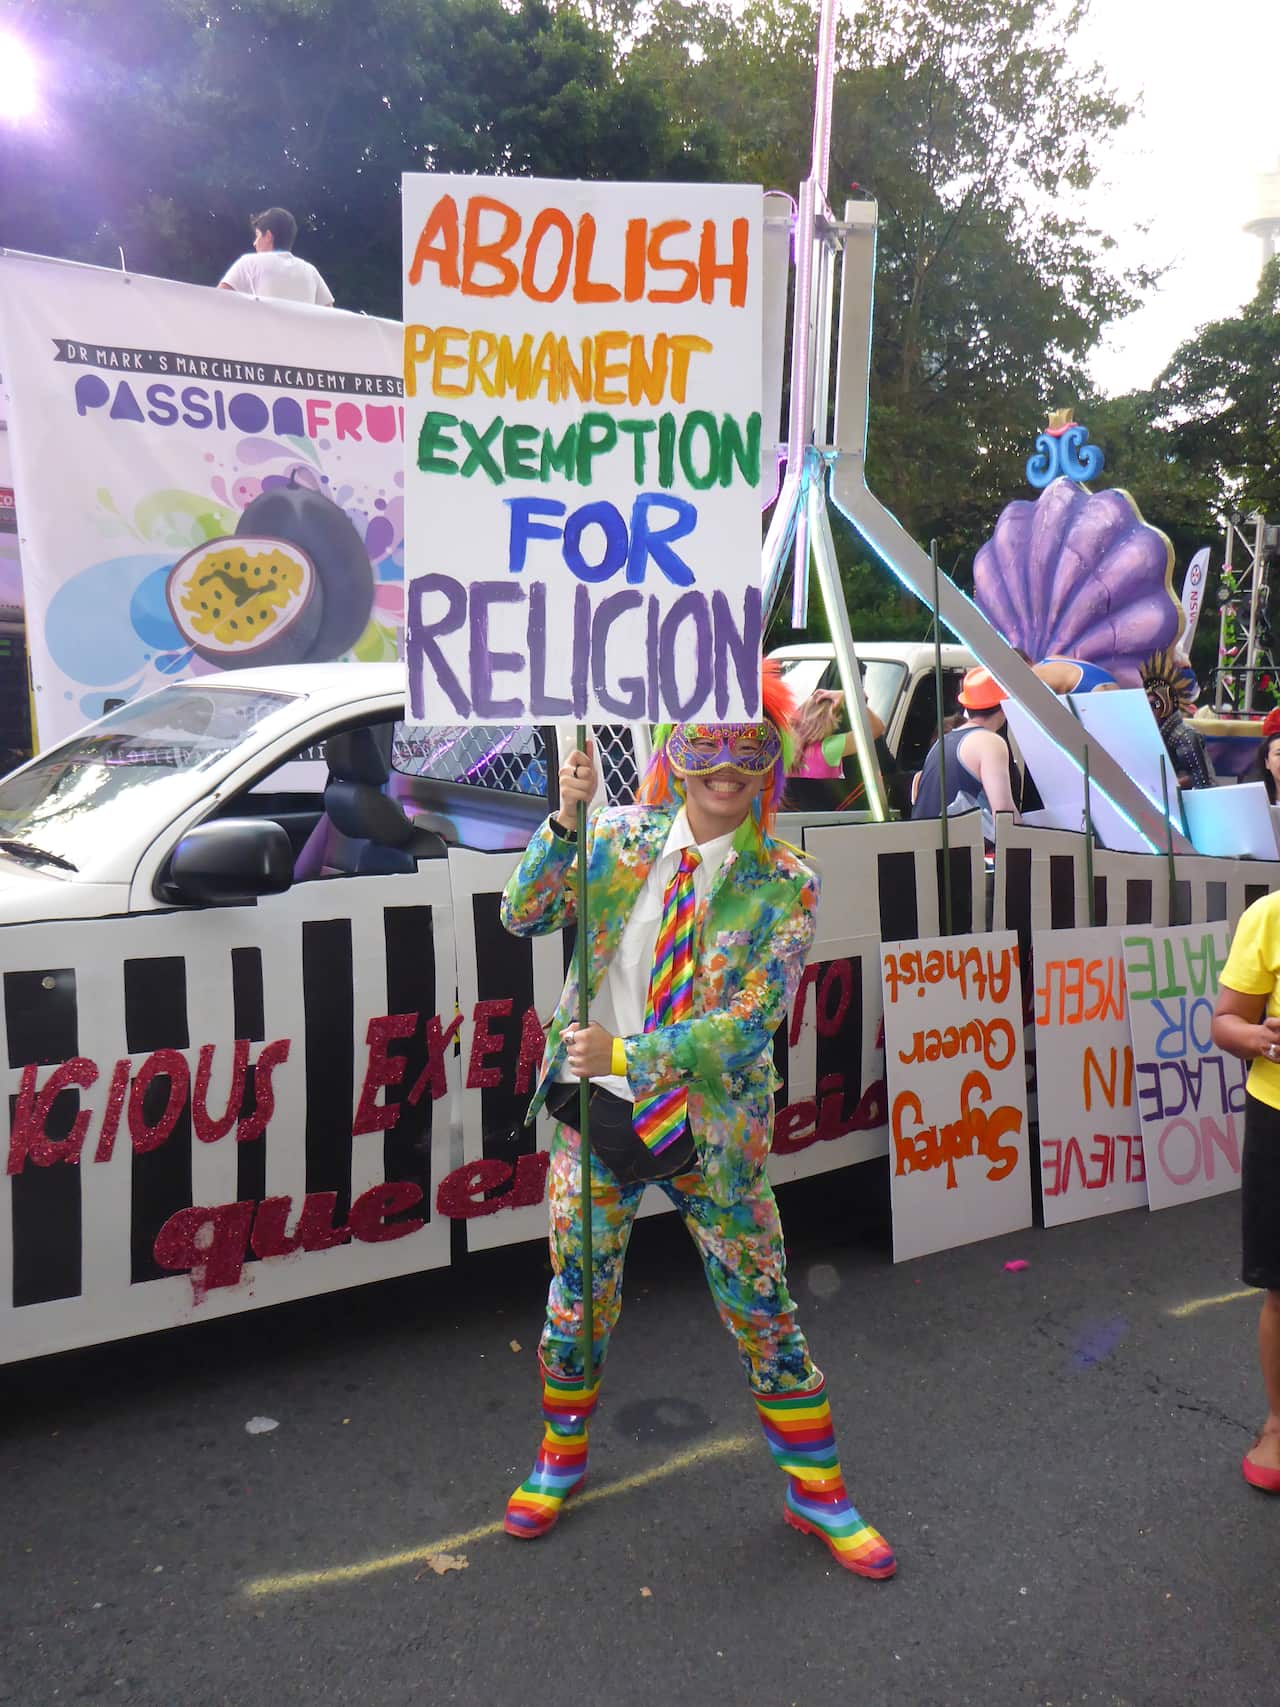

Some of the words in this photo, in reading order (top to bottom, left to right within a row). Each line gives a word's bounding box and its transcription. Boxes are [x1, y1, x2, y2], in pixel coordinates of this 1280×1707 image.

[408, 194, 748, 307] ABOLISH
[67, 344, 88, 361] DR
[176, 357, 265, 382] MARCHING
[273, 369, 346, 390] ACADEMY
[404, 324, 713, 405] PERMANENT
[417, 411, 762, 489] EXEMPTION
[504, 492, 697, 588] FOR
[406, 572, 762, 722] RELIGION
[885, 946, 1012, 1004] Atheist
[898, 1018, 1016, 1071] Queer
[1151, 997, 1214, 1059] OR
[1083, 1046, 1134, 1112] IN
[1136, 1056, 1247, 1122] PLACE
[891, 1069, 1023, 1190] Sydney
[1158, 1113, 1242, 1185] NO
[1042, 1134, 1146, 1196] ELIEVE
